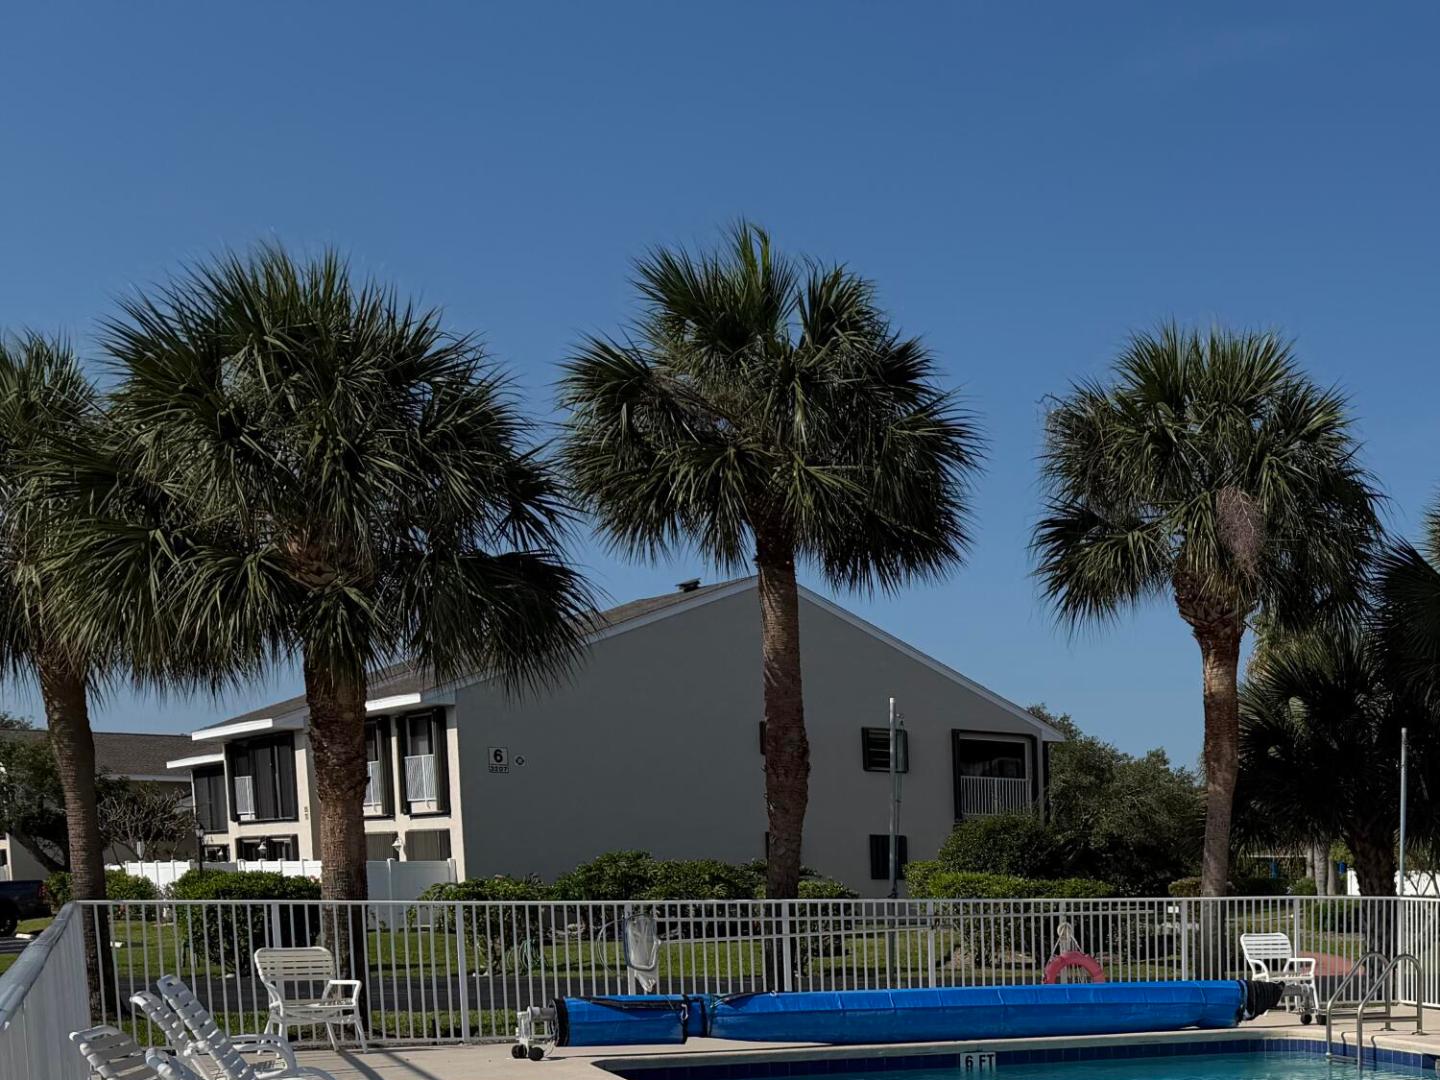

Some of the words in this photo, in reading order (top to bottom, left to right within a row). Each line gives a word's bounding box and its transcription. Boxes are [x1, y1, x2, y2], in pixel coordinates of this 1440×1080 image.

[493, 748, 503, 763] 6
[965, 1055, 974, 1071] 6
[978, 1054, 994, 1071] FT
